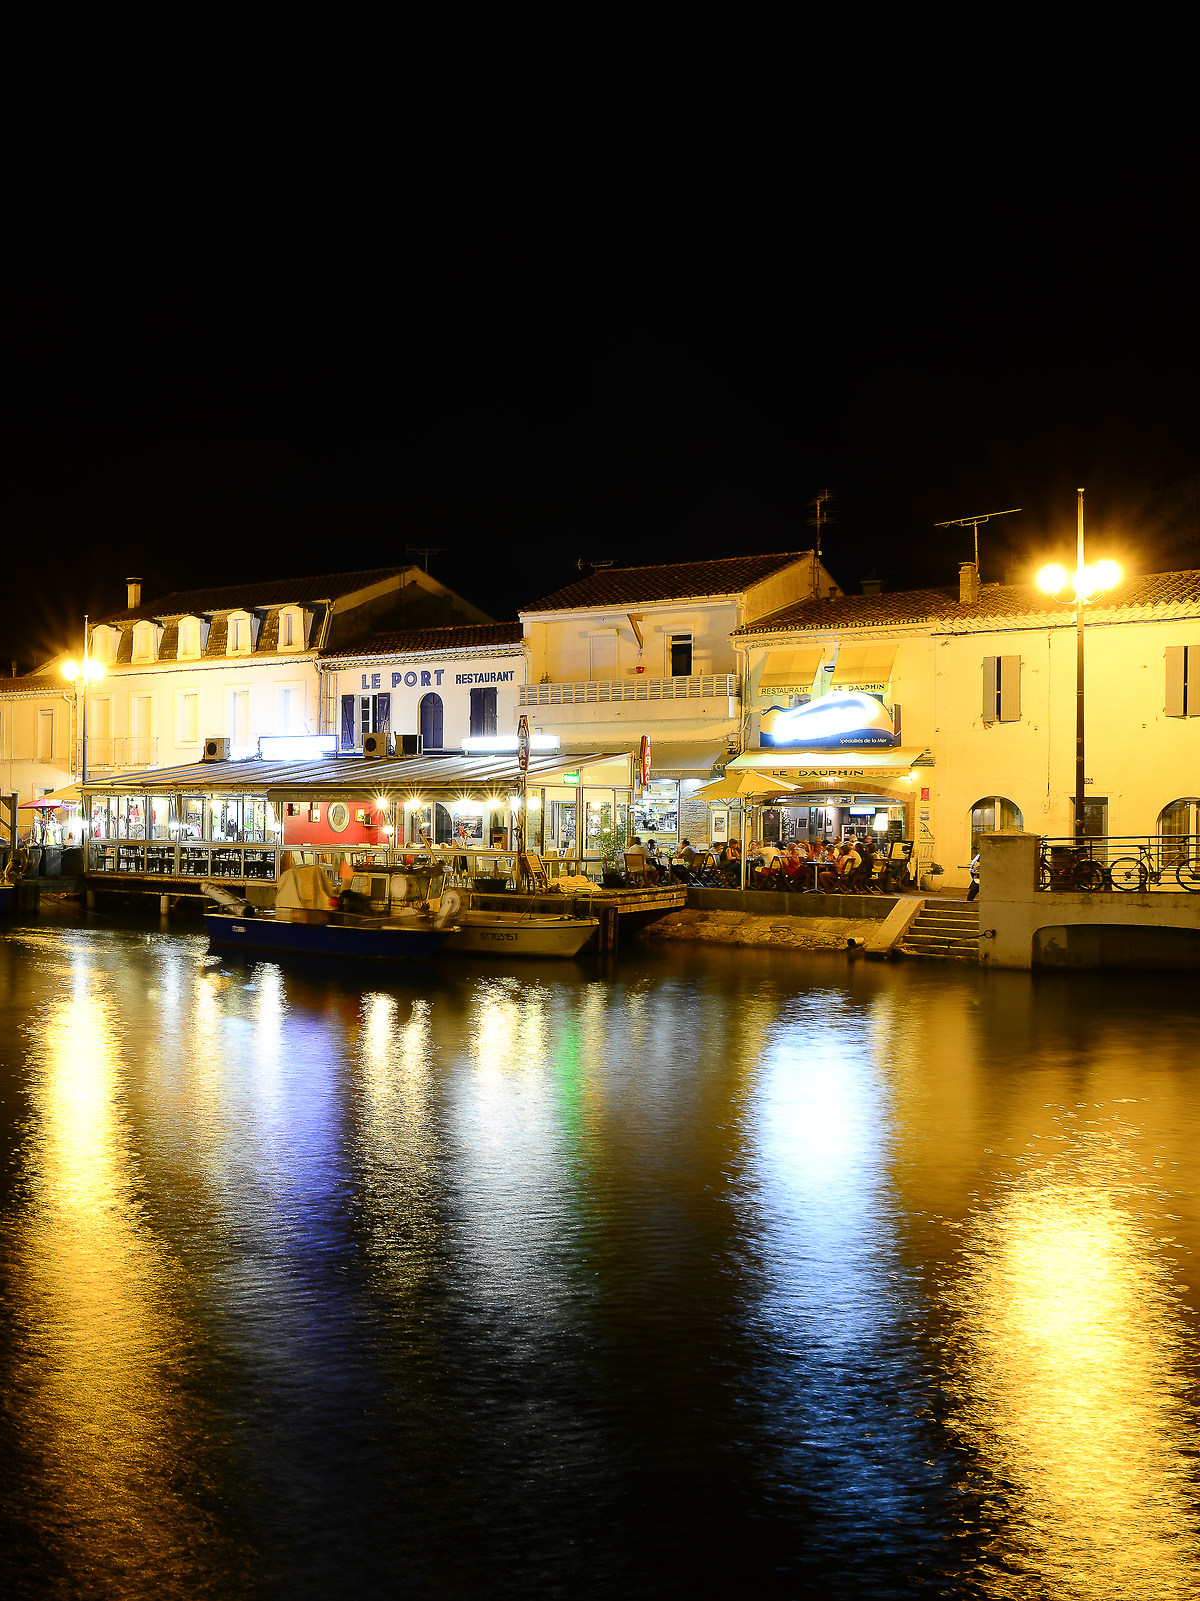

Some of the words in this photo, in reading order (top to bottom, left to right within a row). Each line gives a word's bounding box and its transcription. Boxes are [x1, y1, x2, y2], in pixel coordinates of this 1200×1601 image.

[361, 672, 381, 690] LE
[391, 669, 445, 688] PORT
[455, 670, 515, 685] RESTAURANT
[761, 685, 809, 696] RESTAURANT
[849, 683, 885, 692] DAUPHIN
[798, 769, 864, 777] DAUPHIN
